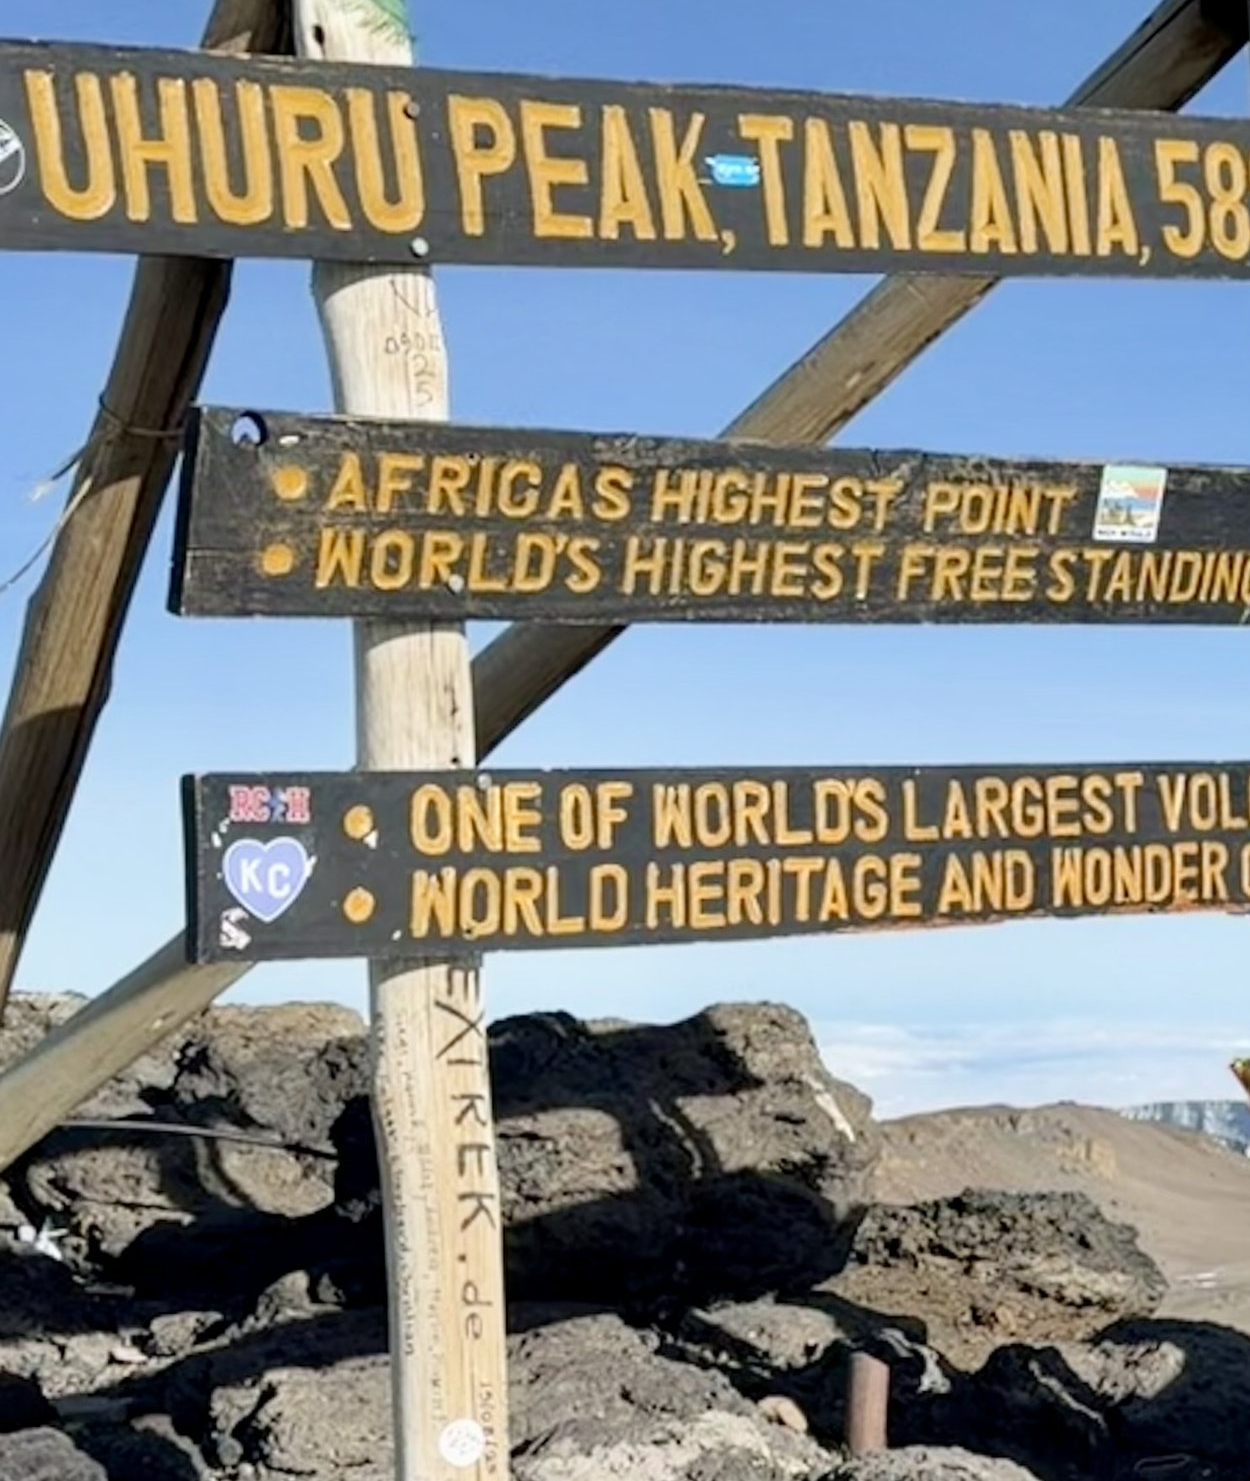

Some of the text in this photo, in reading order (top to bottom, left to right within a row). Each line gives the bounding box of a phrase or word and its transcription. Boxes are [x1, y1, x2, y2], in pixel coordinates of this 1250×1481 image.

[23, 69, 426, 235] UHURU
[447, 94, 738, 256] PEAK,
[738, 112, 1152, 267] TANZANIA,
[650, 468, 904, 534] HIGHEST
[919, 480, 1079, 537] POINT
[315, 526, 601, 594] WORLD'S
[621, 534, 886, 600] HIGHEST
[897, 541, 1040, 603] FREE
[410, 781, 543, 856] ONE
[560, 782, 634, 851] OF
[652, 778, 889, 849] WORLD'S
[903, 771, 1145, 843] LARGEST
[239, 857, 292, 900] KC
[410, 863, 629, 940] WORLD
[646, 852, 923, 930] HERITAGE
[937, 849, 1034, 914] AND
[1051, 841, 1230, 909] WONDER
